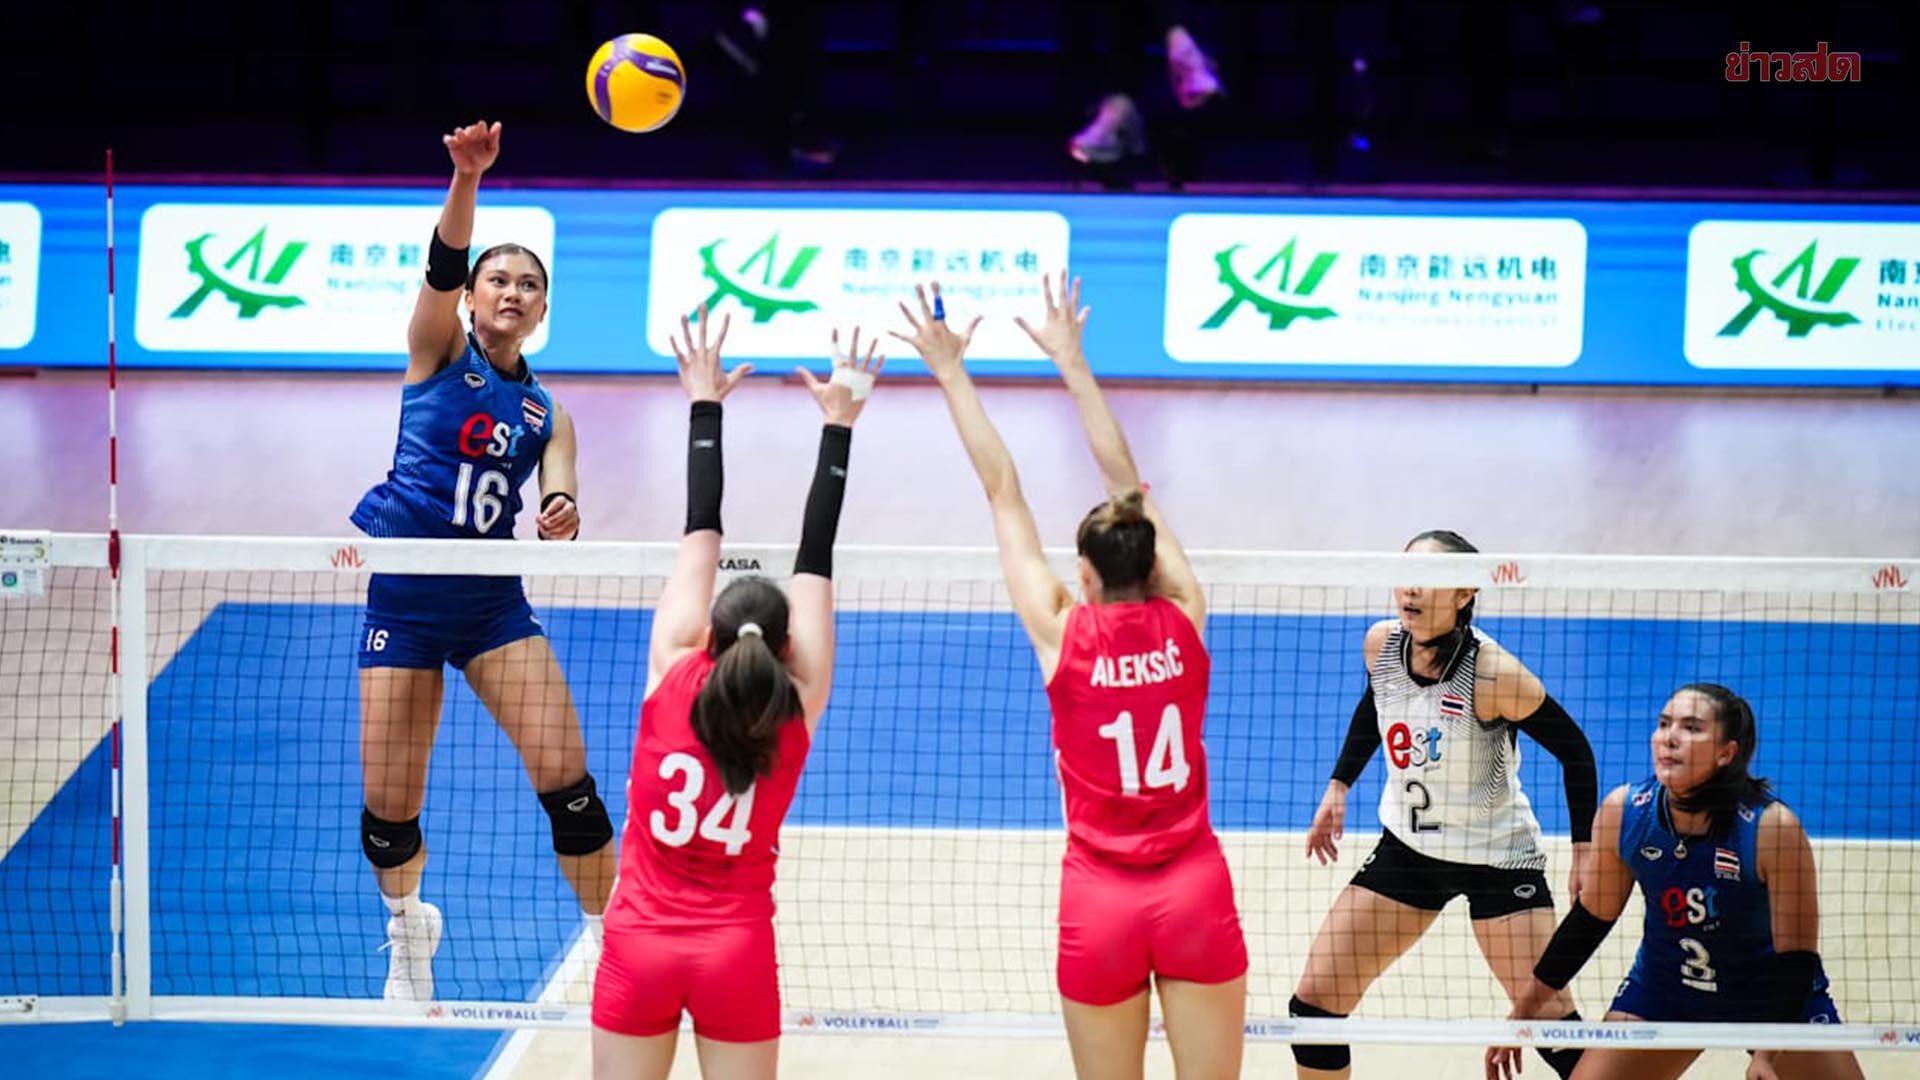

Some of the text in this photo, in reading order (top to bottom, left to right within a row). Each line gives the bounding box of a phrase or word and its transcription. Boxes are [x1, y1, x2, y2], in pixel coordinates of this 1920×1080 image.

[1360, 253, 1557, 280] 南京能远机电
[1359, 288, 1440, 307] Nanjing
[458, 412, 525, 458] est
[452, 462, 509, 534] 16
[718, 558, 761, 571] KASA
[366, 628, 389, 652] 16
[1090, 638, 1184, 687] ALEKSIĆ
[1098, 703, 1191, 796] 14
[1386, 722, 1442, 769] est
[650, 752, 756, 856] 34
[1406, 781, 1442, 833] 2
[1661, 886, 1719, 927] est
[1679, 938, 1718, 992] 3
[453, 1008, 538, 1021] VOLLEYBALL
[824, 1016, 909, 1029] VOLLEYBALL
[1542, 1028, 1628, 1040] VOLLEYBALL
